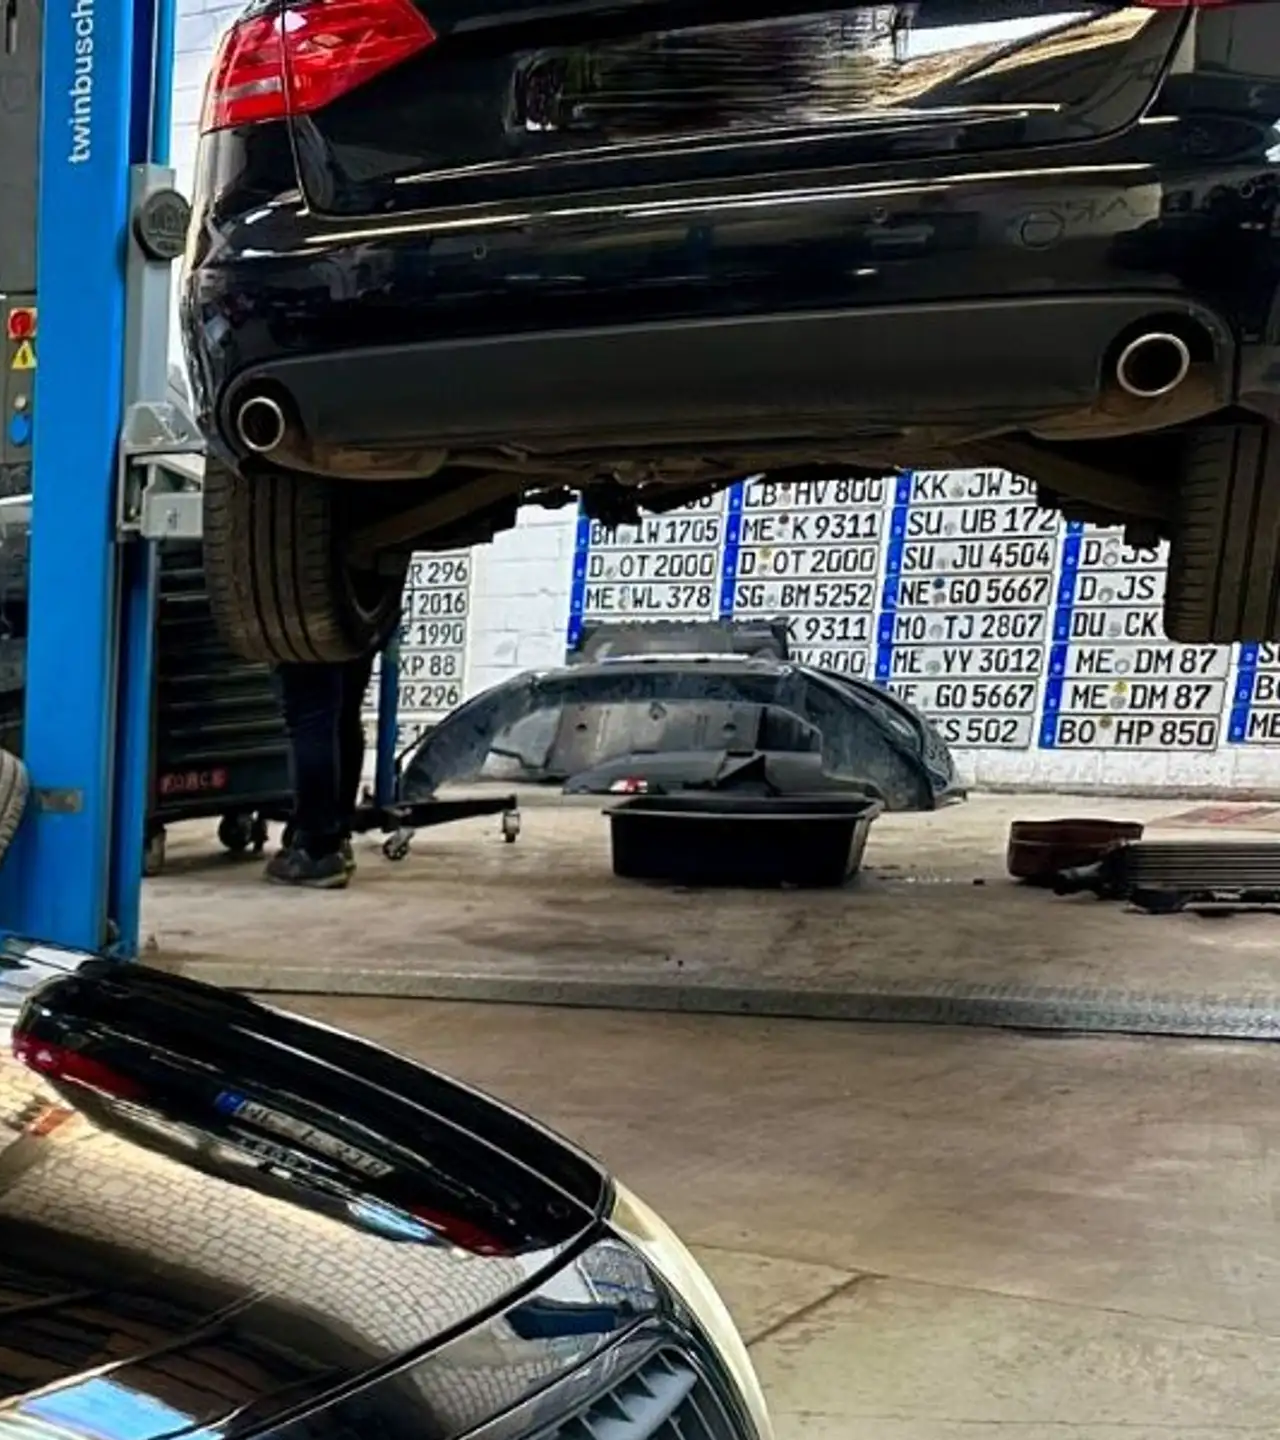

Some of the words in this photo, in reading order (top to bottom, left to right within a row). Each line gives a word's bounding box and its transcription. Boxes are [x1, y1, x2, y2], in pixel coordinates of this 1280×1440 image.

[67, 0, 94, 163] twinbusch
[914, 475, 949, 500] KK
[968, 472, 1003, 497] JW
[665, 519, 718, 543] 1705
[743, 517, 774, 541] ME
[793, 516, 808, 540] K
[815, 513, 877, 539] 9311
[908, 511, 943, 536] SU
[961, 509, 996, 534] UB
[1003, 506, 1056, 532] 172
[590, 554, 604, 578] D
[620, 554, 649, 577] OT
[654, 553, 714, 577] 2000
[741, 551, 756, 574] D
[774, 550, 806, 574] OT
[810, 548, 875, 573] 2000
[903, 546, 934, 570] SU
[952, 544, 983, 569] JU
[990, 542, 1049, 568] 4504
[1084, 540, 1101, 566] D
[428, 561, 468, 584] 296
[586, 587, 614, 609] ME
[633, 586, 661, 608] WL
[667, 585, 711, 608] 378
[735, 583, 765, 607] SG
[781, 584, 811, 607] BM
[814, 583, 872, 607] 5252
[900, 581, 931, 606] NE
[949, 579, 980, 604] GO
[987, 578, 1049, 603] 5667
[1079, 576, 1097, 601] D
[1117, 576, 1156, 600] JS
[418, 592, 466, 615] 2016
[416, 623, 464, 645] 1990
[805, 616, 866, 641] 9311
[896, 616, 926, 641] MO
[944, 615, 975, 640] TJ
[981, 614, 1044, 639] 2807
[1072, 612, 1105, 637] DU
[1124, 612, 1158, 637] CK
[430, 656, 456, 676] 88
[893, 649, 925, 673] ME
[942, 649, 972, 673] YY
[979, 648, 1041, 673] 3012
[1076, 650, 1114, 673] ME
[1133, 650, 1172, 673] DM
[1179, 649, 1218, 673] 87
[420, 684, 459, 707] 296
[935, 684, 966, 709] GO
[971, 683, 1034, 709] 5667
[1071, 684, 1109, 709] ME
[1129, 684, 1167, 709] DM
[1174, 684, 1212, 709] 87
[1255, 675, 1280, 700] B
[966, 718, 1018, 743] 502
[1057, 720, 1096, 744] BO
[1115, 720, 1154, 745] HP
[1159, 720, 1216, 746] 850
